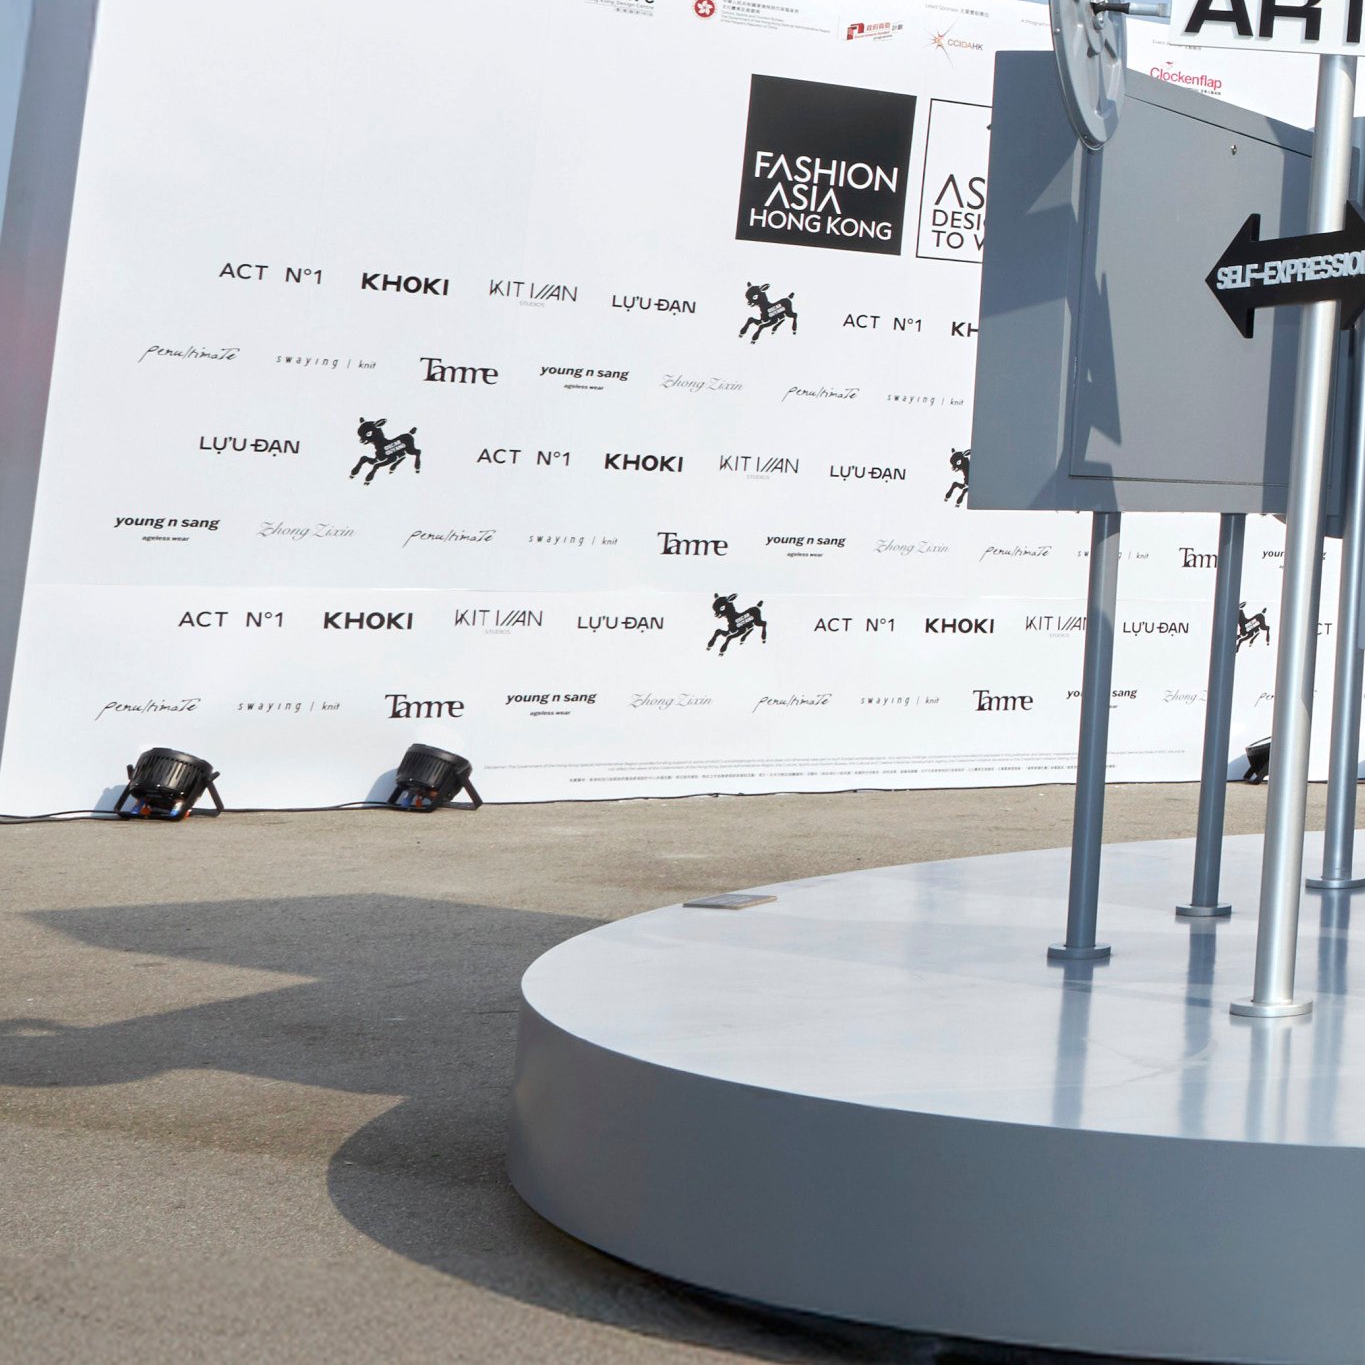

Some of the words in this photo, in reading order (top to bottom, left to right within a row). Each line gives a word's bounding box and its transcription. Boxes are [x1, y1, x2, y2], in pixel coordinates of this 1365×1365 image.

[948, 39, 983, 51] CCIDAHK
[1150, 67, 1222, 90] Clockenflap
[753, 150, 898, 192] FASHION
[764, 184, 841, 215] ASIA
[748, 208, 822, 235] HONG
[827, 214, 892, 240] KONG
[932, 229, 964, 249] TO
[219, 263, 268, 280] ACT
[362, 273, 449, 295] KHOKI
[843, 314, 880, 328] ACT
[540, 367, 583, 378] young
[597, 370, 629, 381] sang
[477, 449, 521, 464] ACT
[605, 453, 683, 472] KHOKI
[114, 518, 165, 529] young
[181, 519, 220, 530] sang
[766, 537, 805, 546] young
[806, 537, 815, 545] n
[817, 538, 846, 547] sang
[179, 611, 228, 627] ACT
[324, 612, 413, 629] KHOKI
[814, 618, 852, 632] ACT
[926, 618, 994, 633] KHOKI
[506, 694, 550, 705] young
[564, 694, 597, 704] sang
[1112, 687, 1138, 699] sang
